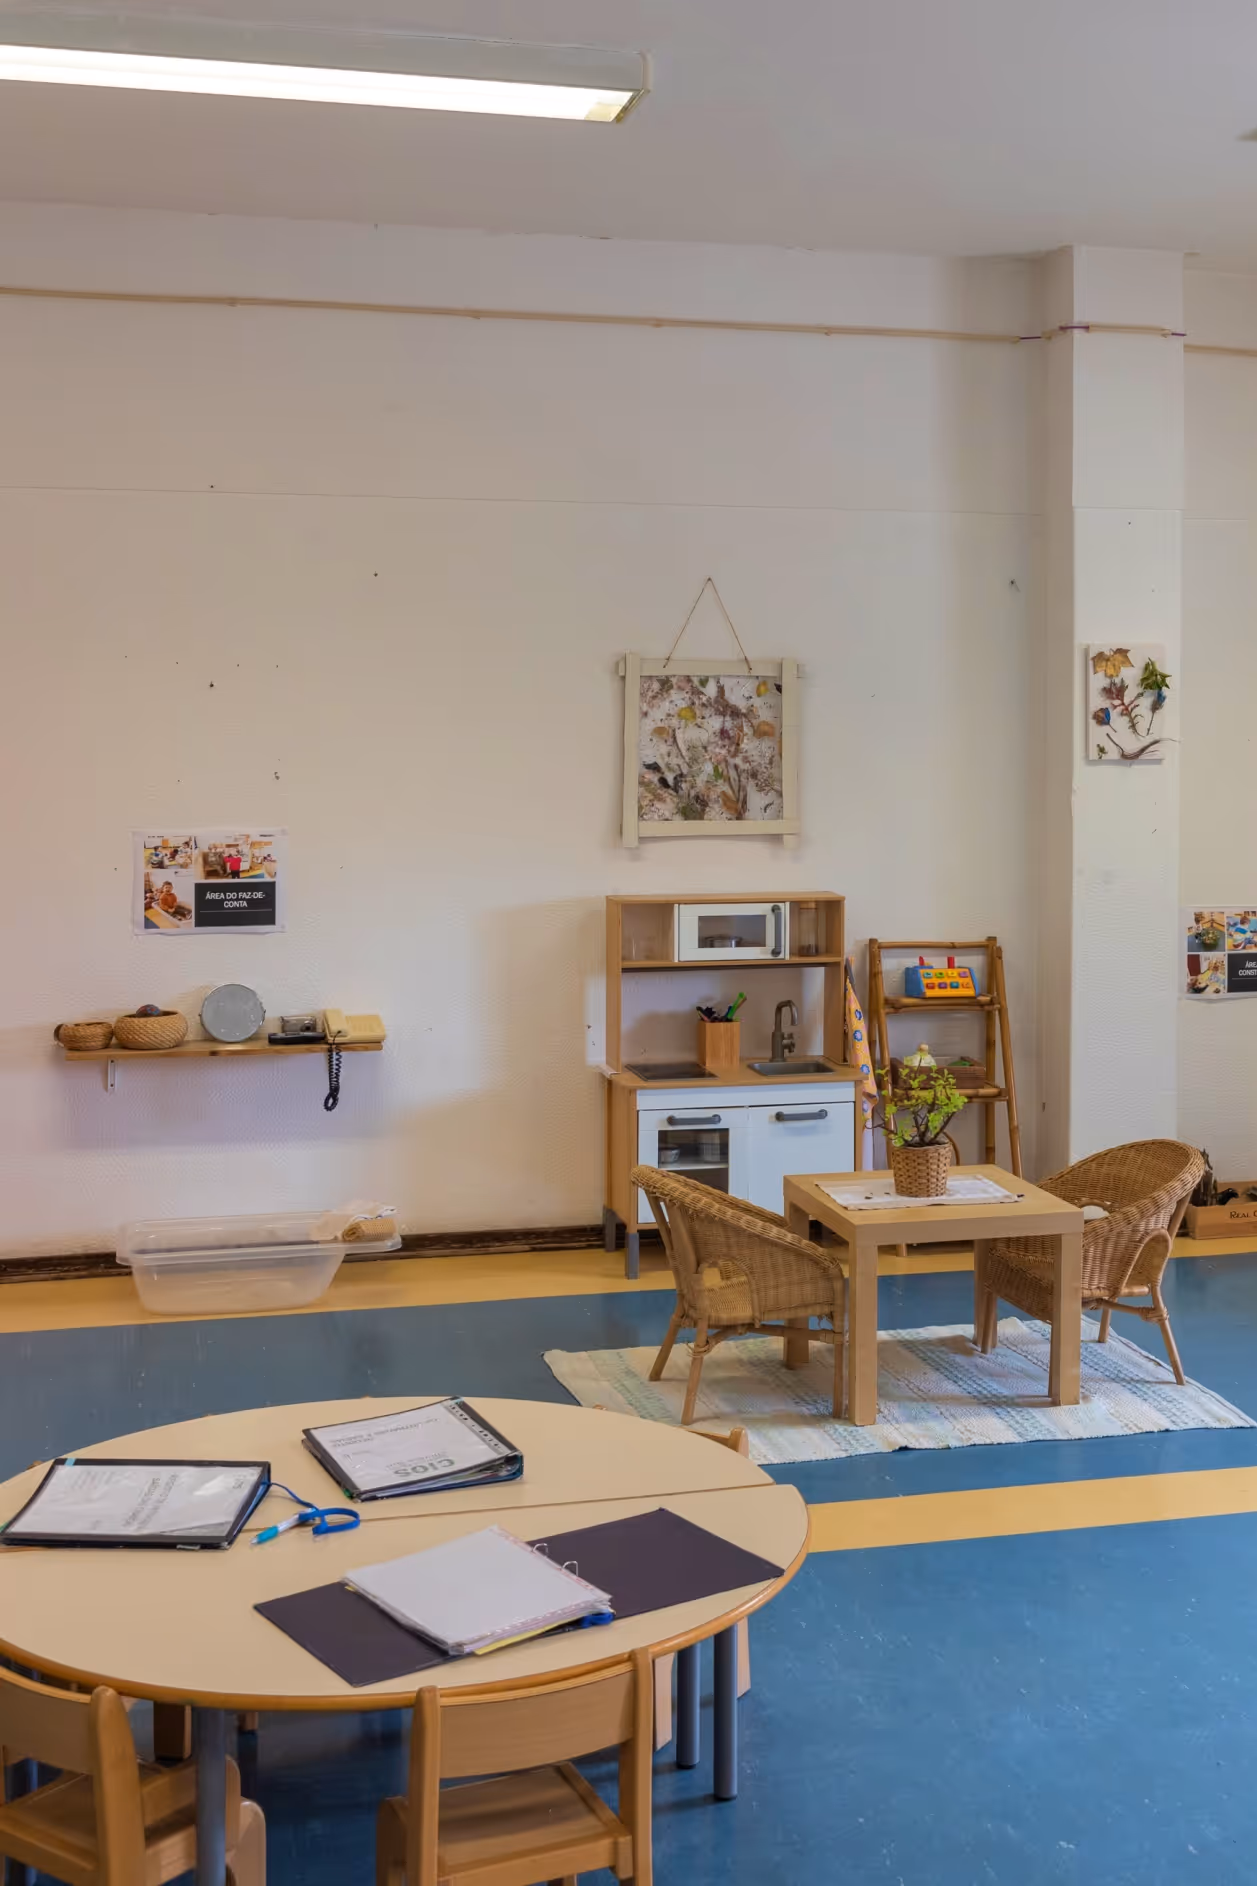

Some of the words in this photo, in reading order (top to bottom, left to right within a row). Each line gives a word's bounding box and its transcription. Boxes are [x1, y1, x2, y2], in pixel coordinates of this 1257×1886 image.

[205, 891, 224, 900] ÁREA
[239, 891, 265, 899] FAZ-DE-
[223, 900, 248, 908] CONTA
